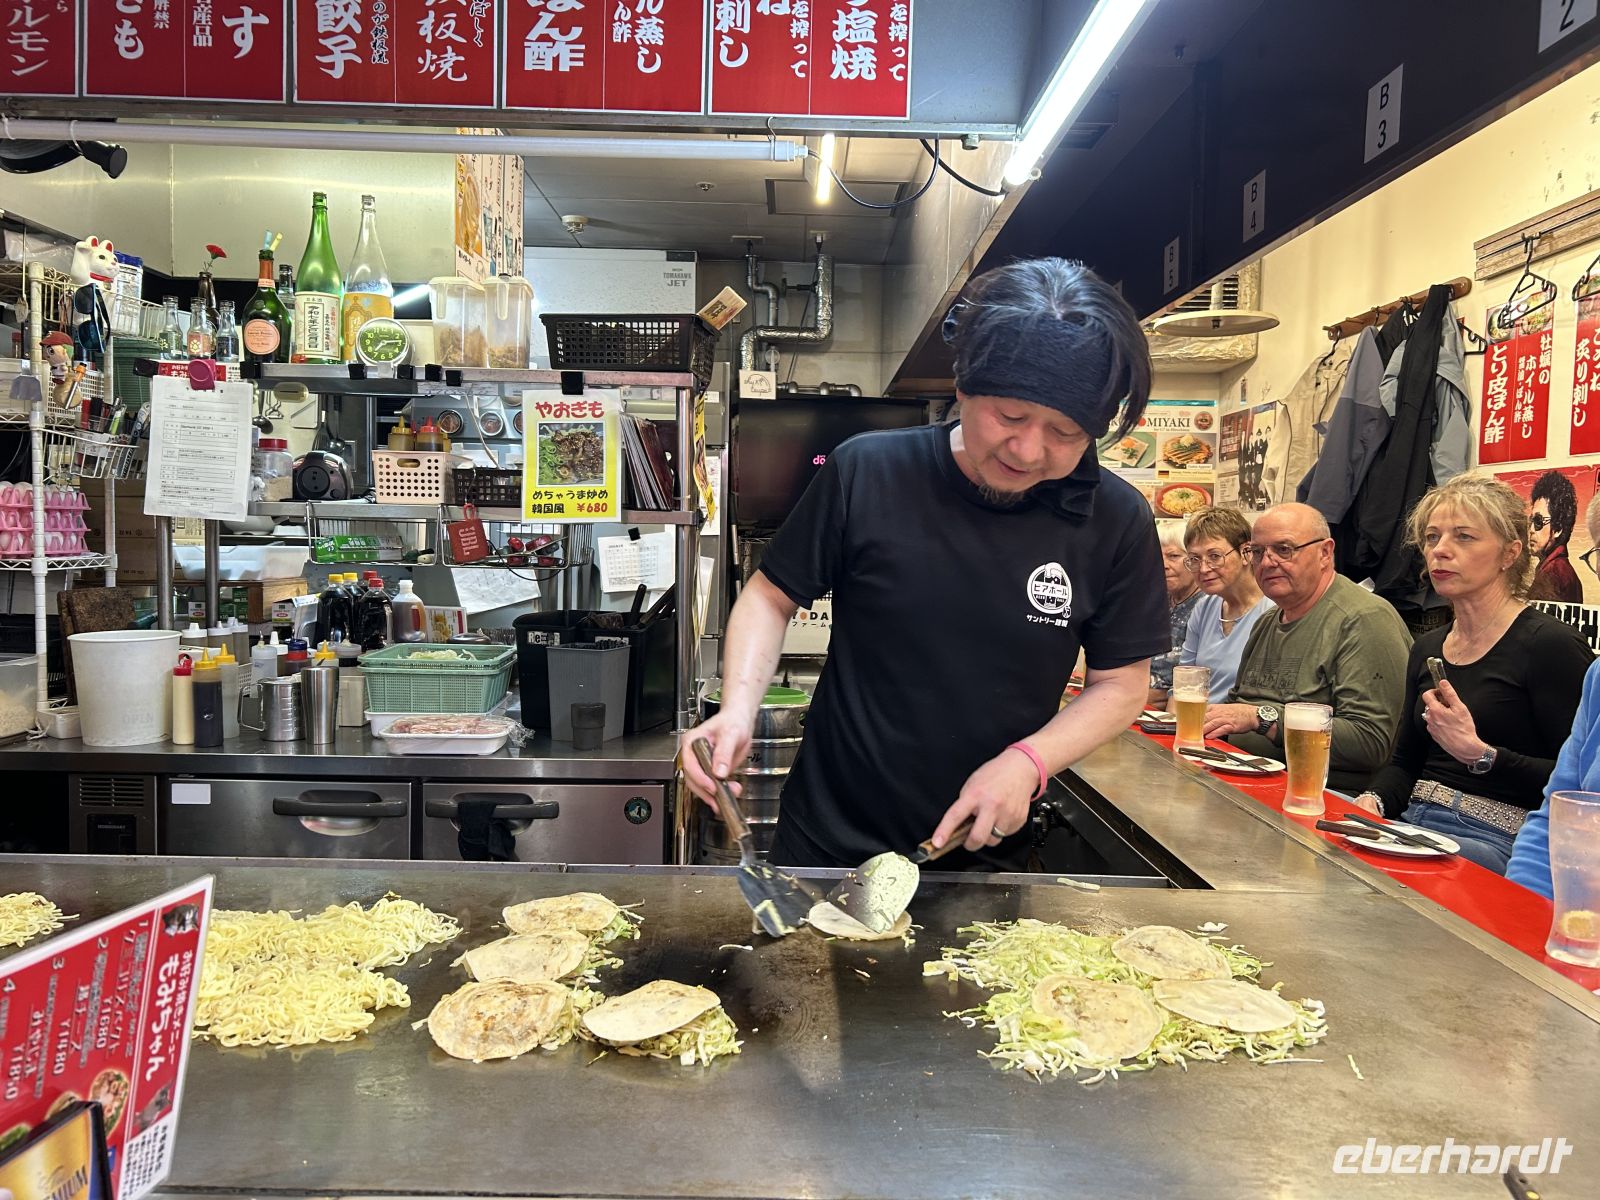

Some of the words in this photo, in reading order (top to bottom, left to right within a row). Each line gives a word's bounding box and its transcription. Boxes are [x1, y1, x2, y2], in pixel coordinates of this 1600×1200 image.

[7, 0, 49, 77] ルモン
[416, 0, 469, 82] 板焼
[535, 401, 605, 419] やおぎも
[531, 503, 565, 514] 韓国風
[576, 502, 608, 513] ¥680
[532, 490, 608, 500] めちゃうま炒め
[145, 952, 180, 1082] もみちゃん
